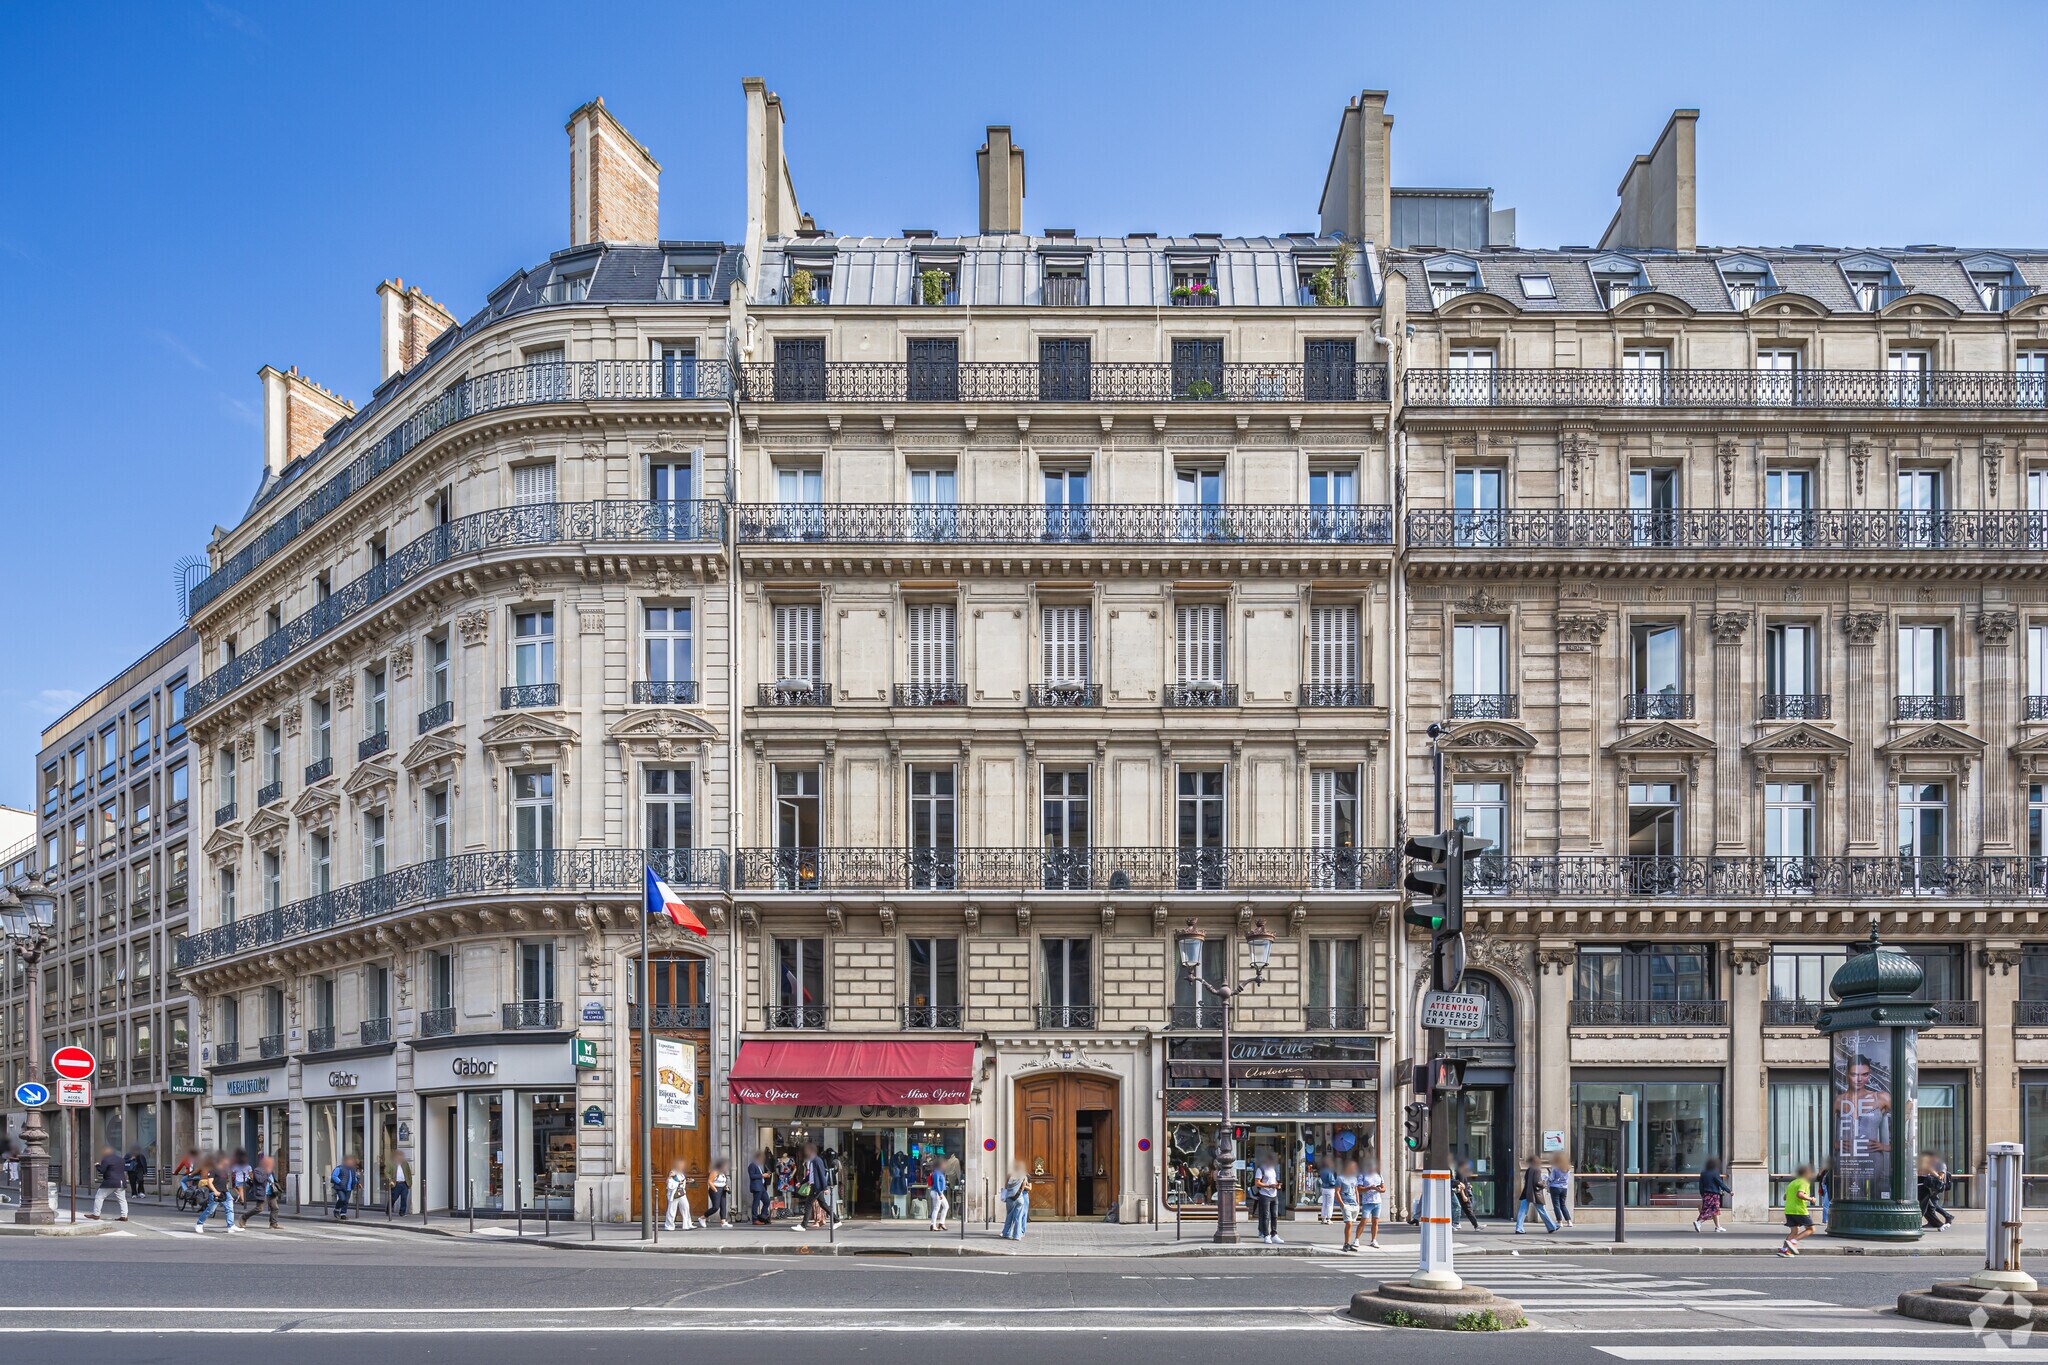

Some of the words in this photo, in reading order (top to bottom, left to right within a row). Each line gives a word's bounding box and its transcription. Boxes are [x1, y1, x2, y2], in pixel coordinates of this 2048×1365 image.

[1435, 995, 1474, 1004] PIÉTONS
[1430, 1002, 1478, 1012] ATTENTION
[1427, 1010, 1479, 1020] TRAVERSEZ
[1448, 1019, 1478, 1028] TEMPS
[452, 1057, 498, 1075] Gabor
[1245, 1066, 1304, 1079] Antoine
[328, 1071, 359, 1087] Gabor
[666, 1097, 674, 1105] de
[733, 1087, 762, 1099] Miss
[764, 1088, 800, 1102] Opéra
[900, 1088, 929, 1099] Miss
[932, 1088, 966, 1101] Opéra
[1839, 1094, 1875, 1117] DÉ
[1839, 1119, 1860, 1137] FI
[1839, 1135, 1870, 1157] LÉ
